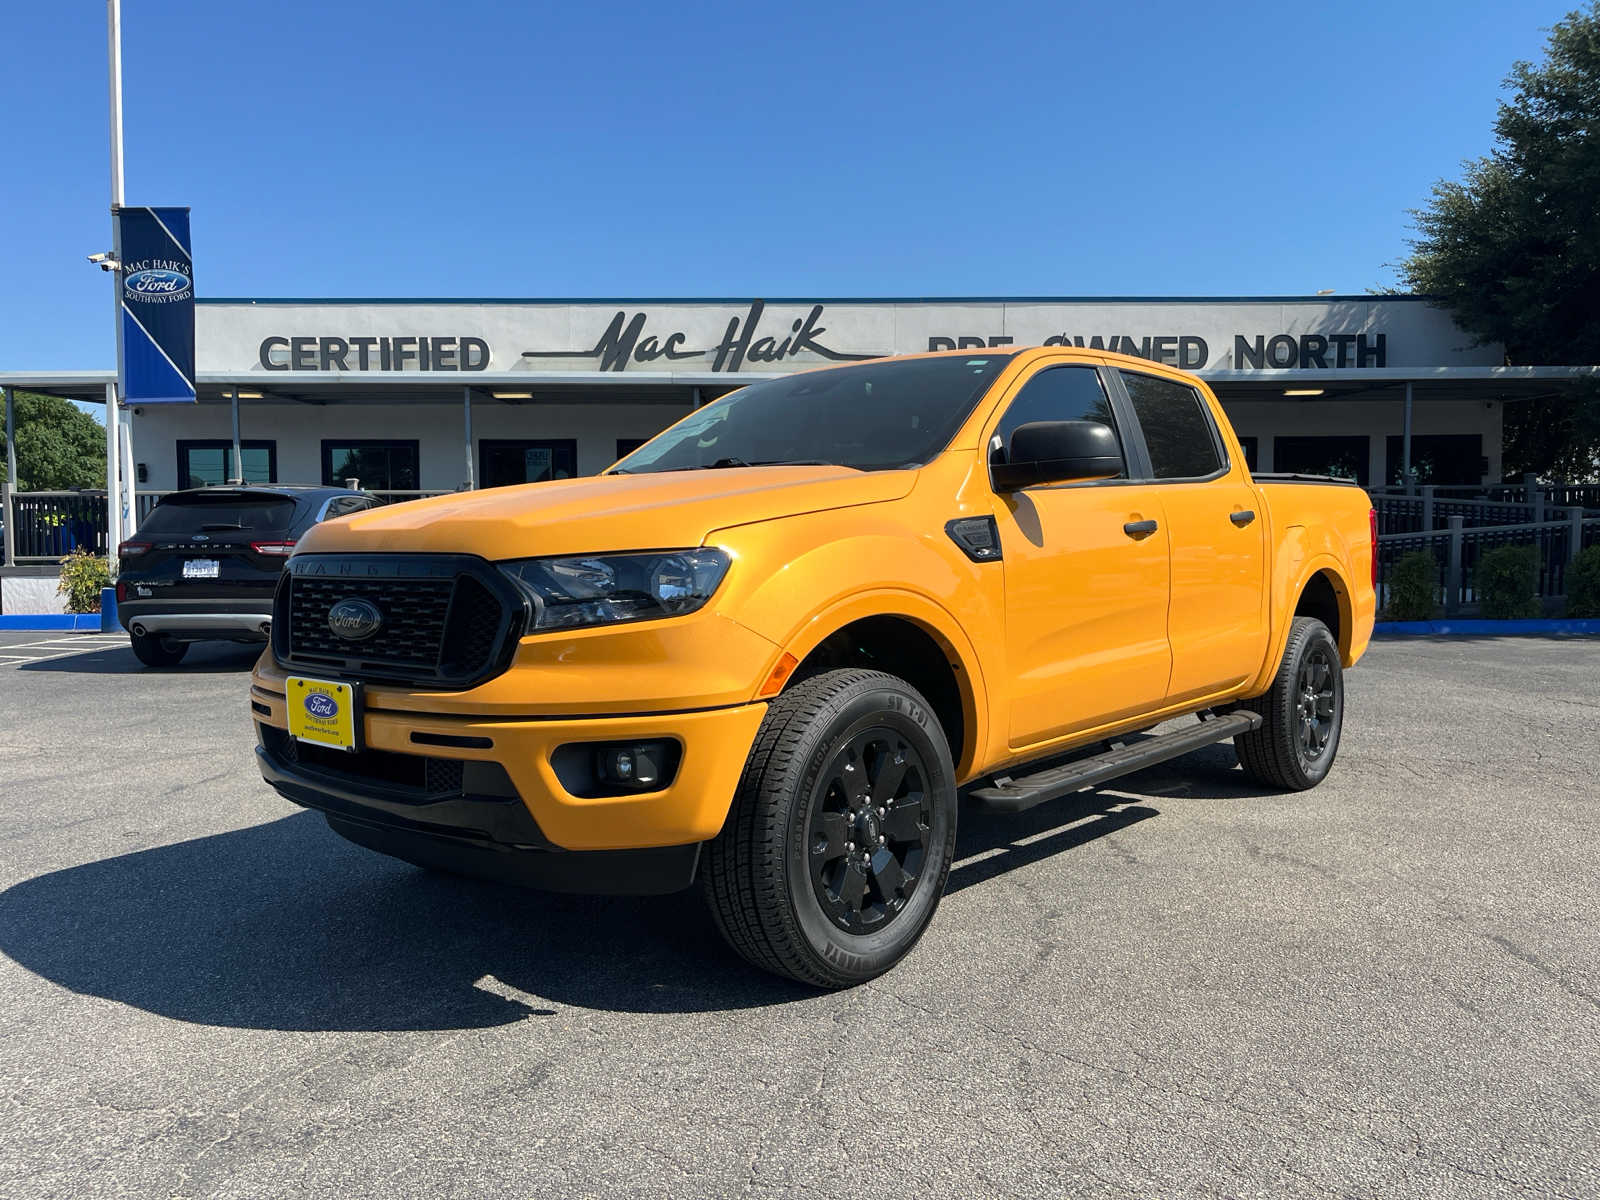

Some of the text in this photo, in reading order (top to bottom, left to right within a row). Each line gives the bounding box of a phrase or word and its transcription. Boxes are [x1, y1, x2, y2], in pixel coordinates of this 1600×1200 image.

[125, 259, 190, 275] MAC HAIK'S
[136, 273, 177, 291] Ford
[125, 290, 191, 303] SOUTHWAY FORD
[522, 299, 890, 372] Mac Haik
[259, 336, 490, 371] CERTIFIED
[1234, 333, 1387, 369] NORTH
[334, 605, 363, 628] Ford
[310, 696, 332, 716] Ford
